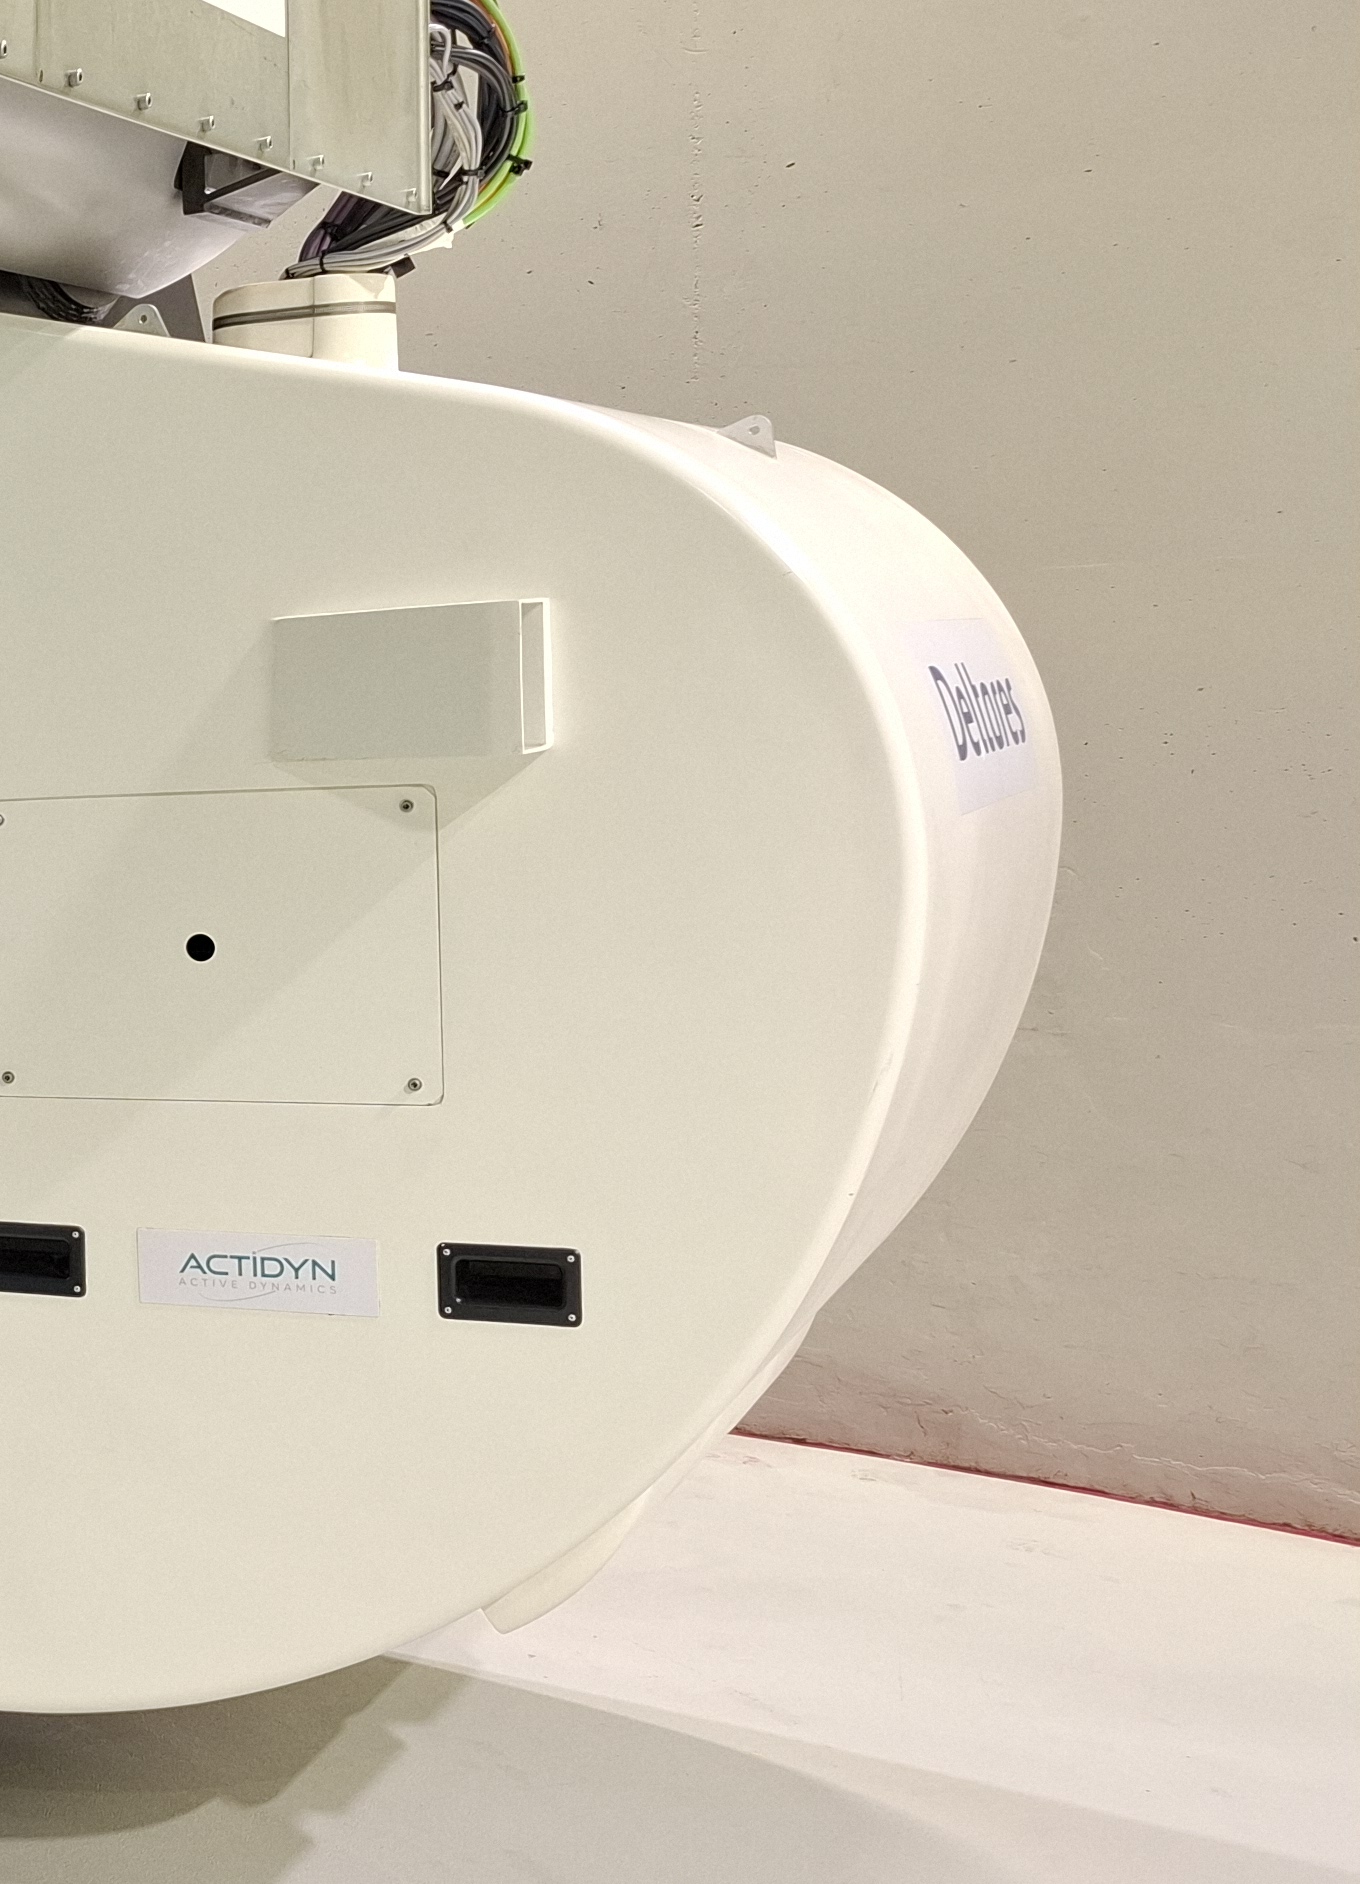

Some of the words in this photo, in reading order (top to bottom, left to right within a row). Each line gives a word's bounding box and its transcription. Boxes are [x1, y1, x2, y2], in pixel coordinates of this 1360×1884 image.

[928, 662, 1026, 761] Deltares
[178, 1277, 239, 1289] ACTIVE
[248, 1280, 337, 1295] DYNAMICS
